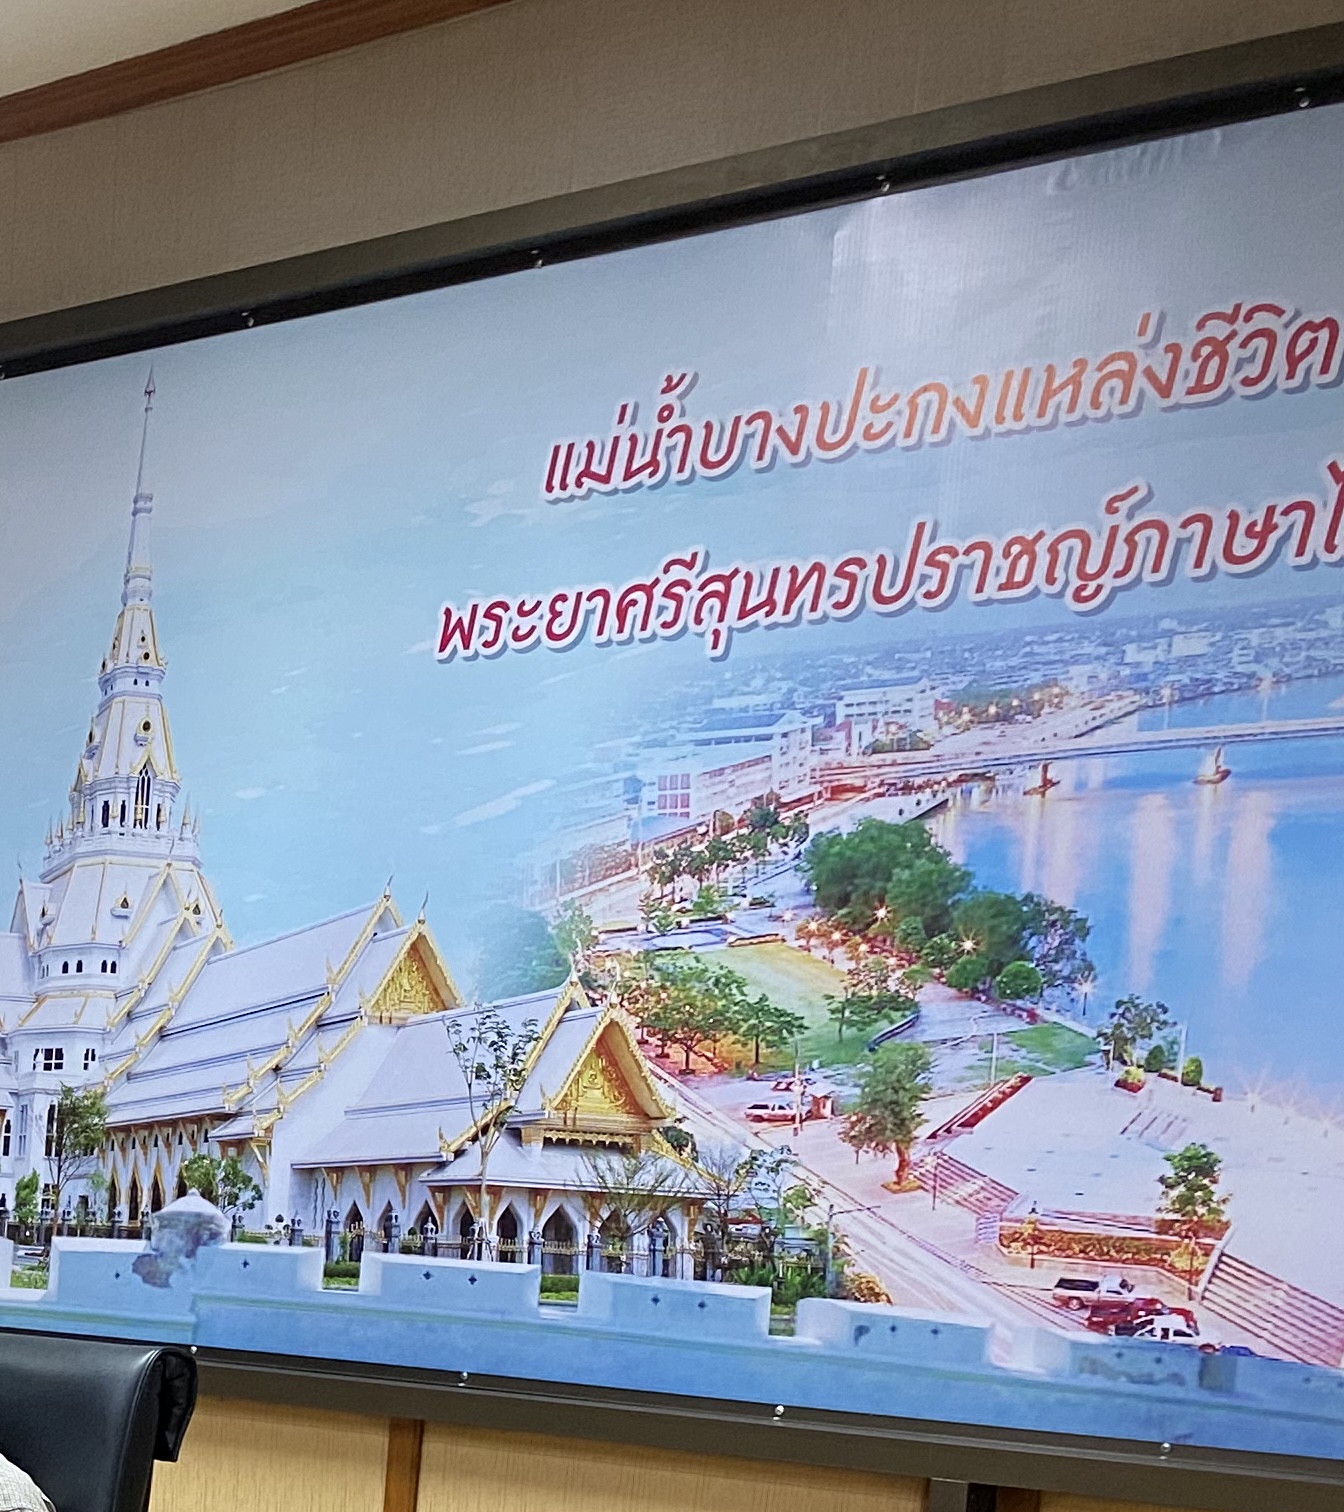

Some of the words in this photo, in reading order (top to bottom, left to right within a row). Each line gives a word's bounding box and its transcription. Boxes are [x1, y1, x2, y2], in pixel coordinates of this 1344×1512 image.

[543, 301, 1340, 496] แม่น้ำบางปะกงแหล่งชีวิต
